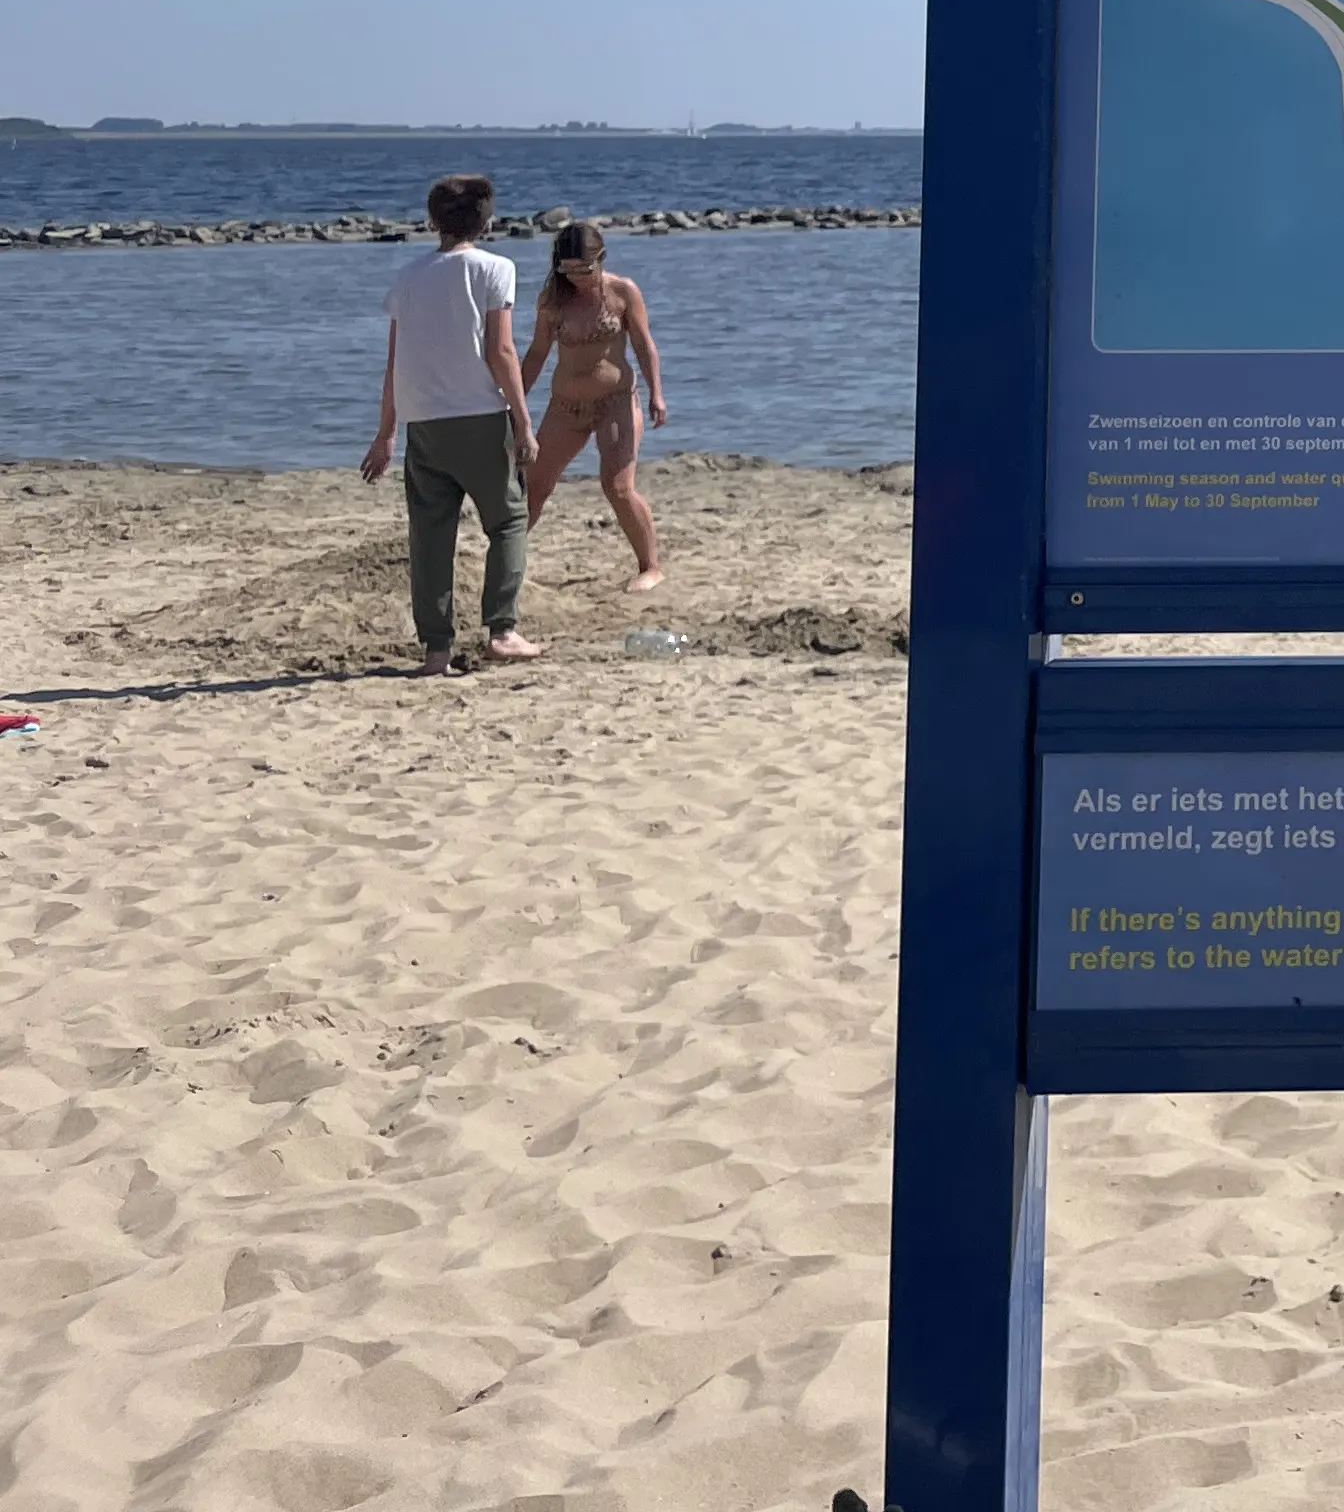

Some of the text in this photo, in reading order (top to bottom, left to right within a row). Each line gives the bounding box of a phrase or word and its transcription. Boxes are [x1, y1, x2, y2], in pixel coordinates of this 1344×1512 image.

[1088, 414, 1203, 429] Zwemseizoen
[1207, 416, 1228, 428] en
[1232, 413, 1302, 429] controle
[1306, 416, 1336, 428] van
[1087, 439, 1119, 451] van
[1124, 436, 1131, 451] 1
[1138, 437, 1168, 451] mei
[1173, 437, 1196, 451] tot
[1199, 439, 1221, 451] en
[1225, 436, 1257, 450] met
[1261, 435, 1281, 450] 30
[1087, 471, 1175, 489] Swimming
[1179, 473, 1240, 486] season
[1244, 471, 1276, 485] and
[1280, 471, 1327, 485] water
[1086, 492, 1321, 512] from 1 May to 30 September
[1073, 788, 1122, 813] Als
[1131, 793, 1162, 813] er
[1171, 786, 1224, 812] iets
[1234, 788, 1289, 812] met
[1298, 786, 1344, 811] het
[1072, 825, 1201, 855] vermeld,
[1210, 825, 1274, 856] zegt
[1284, 823, 1336, 849] iets
[1071, 907, 1092, 933] If
[1099, 906, 1201, 932] there's
[1211, 904, 1341, 936] anything
[1069, 945, 1156, 970] refers
[1166, 945, 1195, 969] to
[1205, 943, 1251, 969] the
